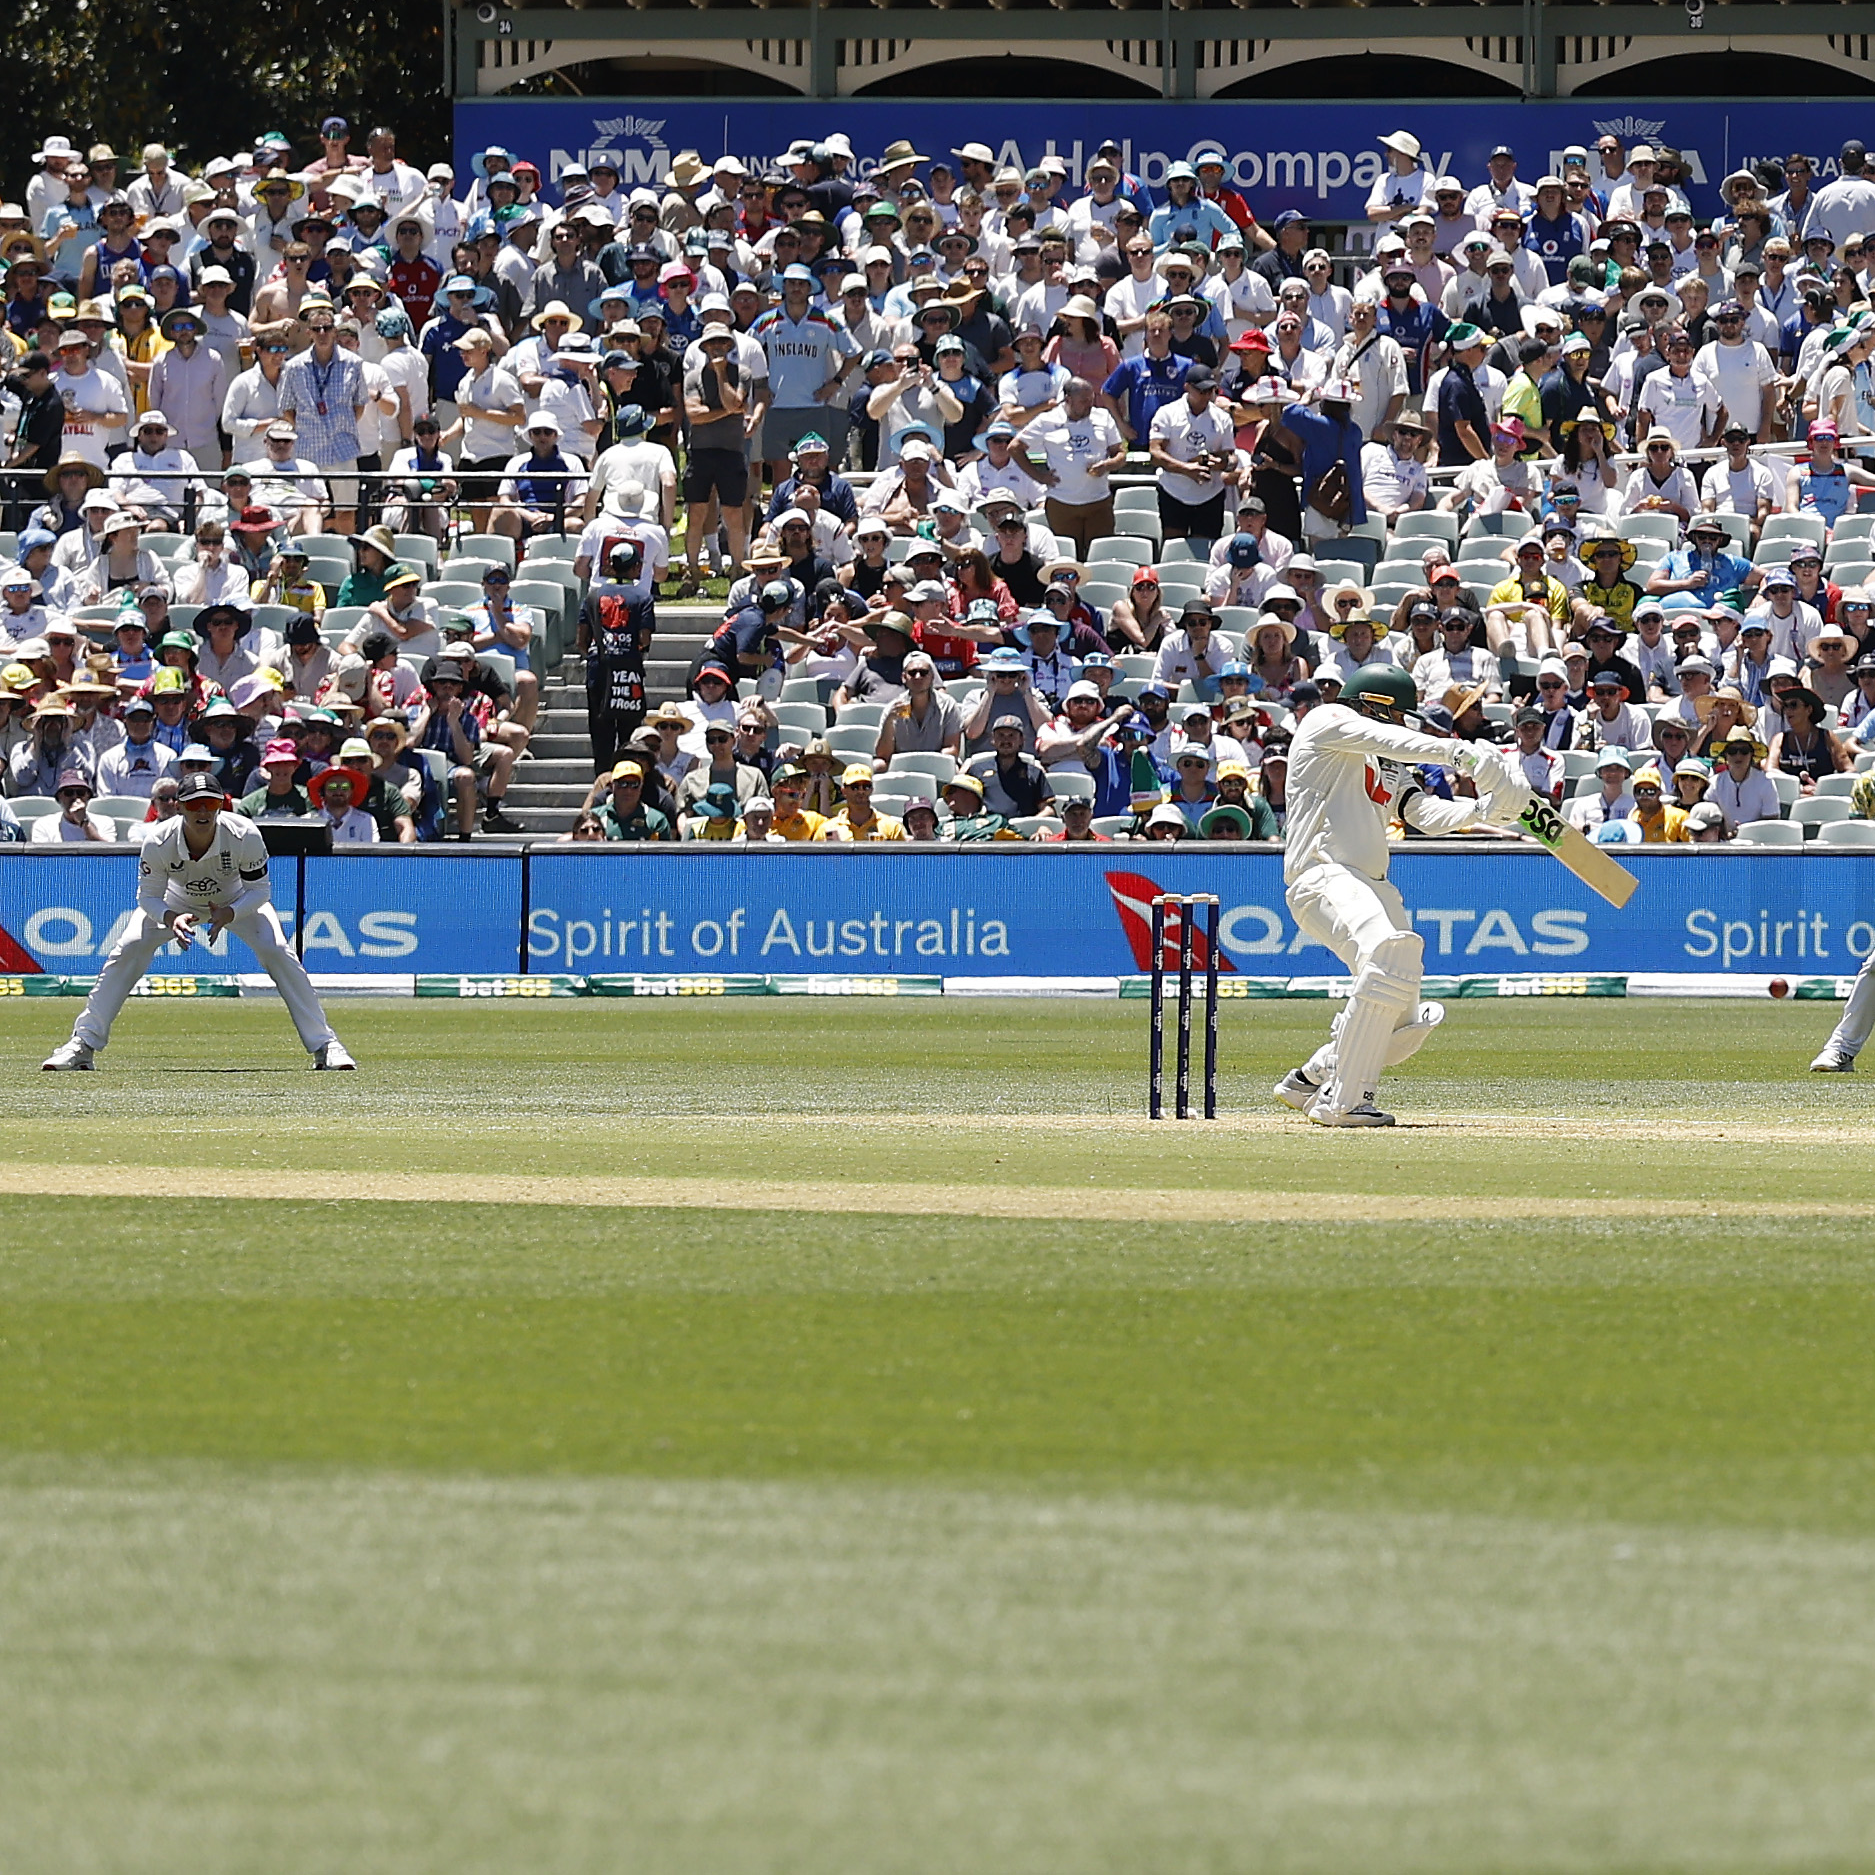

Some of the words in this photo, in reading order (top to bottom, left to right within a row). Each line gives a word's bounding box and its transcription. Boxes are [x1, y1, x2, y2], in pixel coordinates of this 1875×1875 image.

[497, 20, 512, 34] 34
[611, 685, 631, 697] THE
[609, 697, 642, 712] FROGS
[526, 908, 675, 968] Spirit
[690, 907, 746, 958] of
[760, 907, 1010, 958] Australia
[1684, 909, 1829, 969] Spirit
[458, 977, 551, 997] bet365
[633, 976, 725, 997] bet365
[806, 976, 900, 997] bet365
